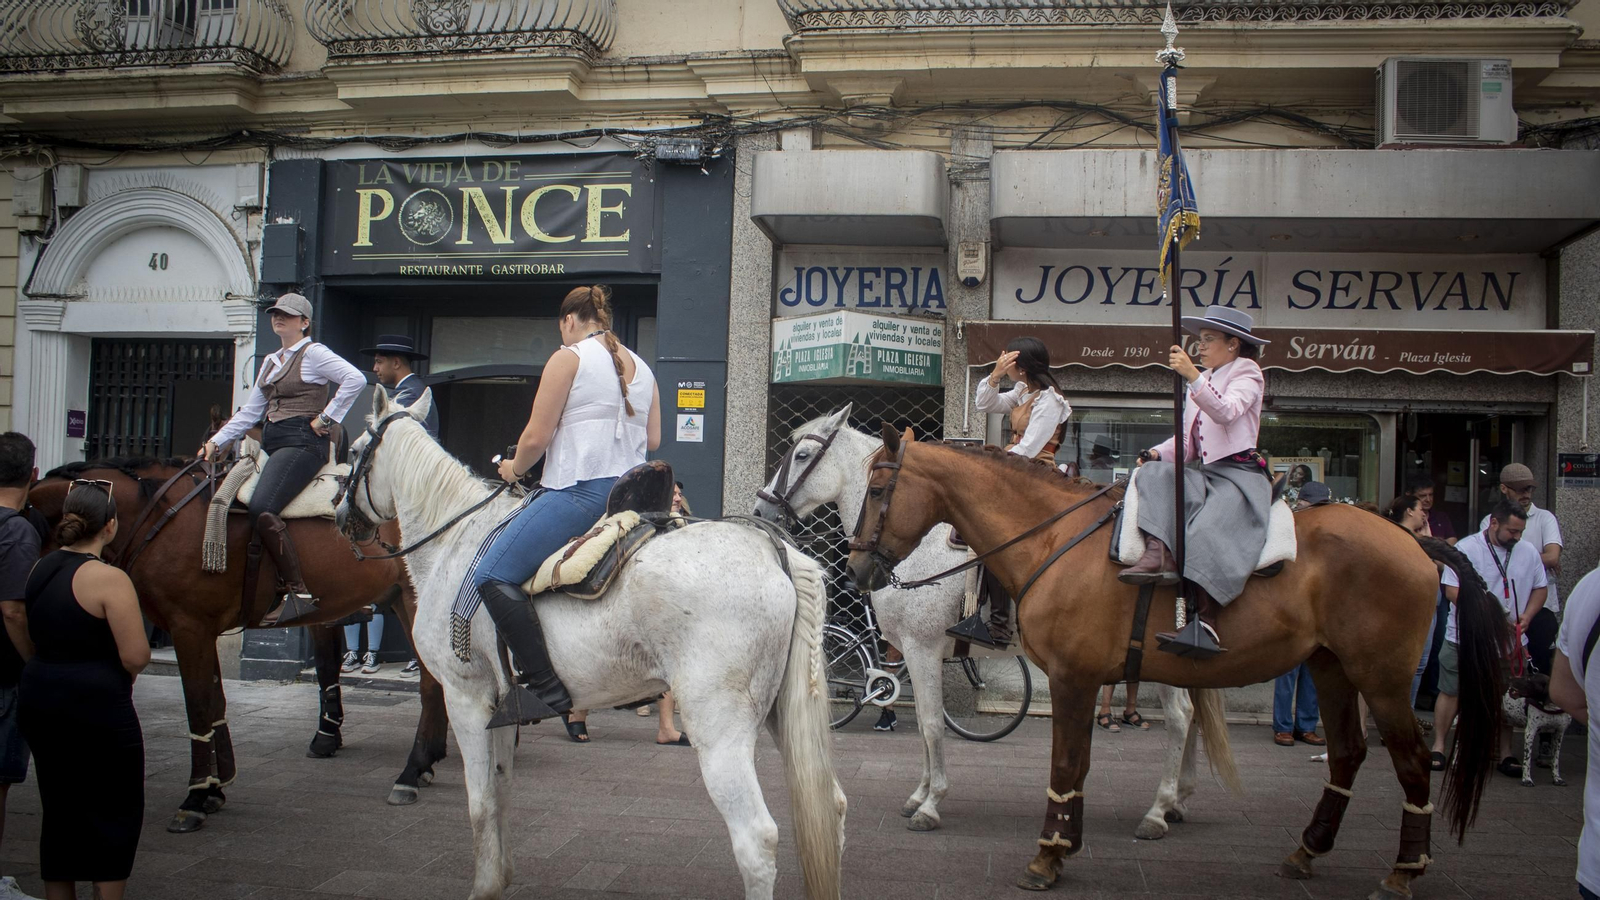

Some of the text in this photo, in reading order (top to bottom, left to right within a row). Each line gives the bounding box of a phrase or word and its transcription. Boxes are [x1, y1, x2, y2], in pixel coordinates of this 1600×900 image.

[358, 160, 521, 188] LA VIEJA DE
[148, 252, 169, 271] 40
[400, 263, 565, 276] RESTAURANTE GASTROBAR
[779, 266, 947, 308] JOYERIA
[1287, 269, 1522, 312] SERVAN
[792, 321, 811, 333] alquiler
[819, 318, 834, 329] venta
[836, 316, 843, 326] de
[872, 319, 942, 337] alquiler y venta de
[790, 331, 816, 343] viviendas
[822, 327, 842, 339] locales
[869, 330, 941, 348] viviendas y locales
[794, 347, 834, 363] PLAZA IGLESIA
[877, 349, 931, 367] PLAZA IGLESIA
[1081, 346, 1115, 358] Desde
[1123, 346, 1150, 358] 1930
[1287, 336, 1376, 361] Serván
[1399, 351, 1431, 363] Plaza
[1433, 352, 1472, 366] Iglesia
[798, 362, 829, 373] INMOBILIARIA
[882, 364, 925, 377] INMOBILIARIA
